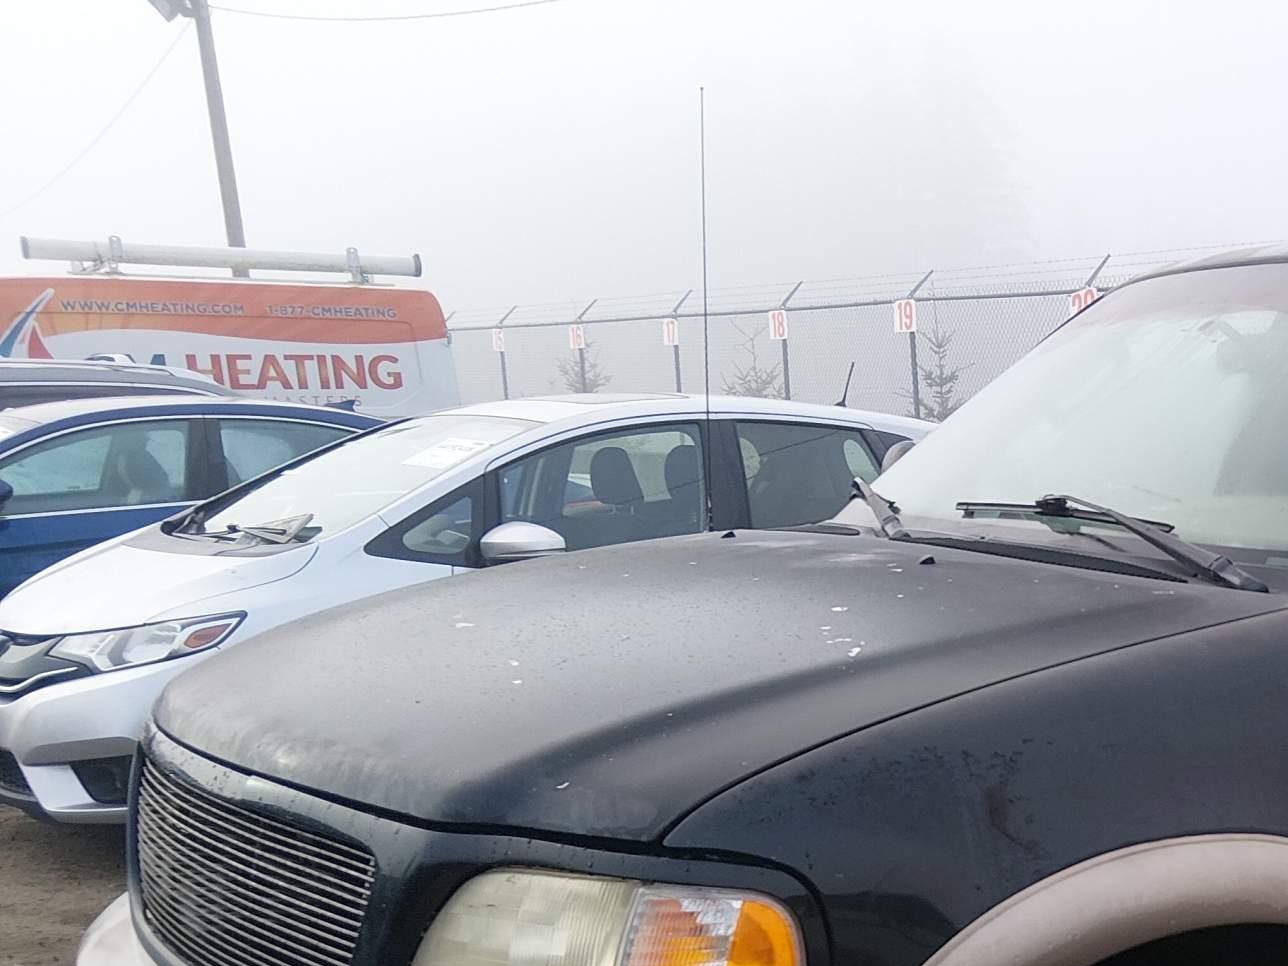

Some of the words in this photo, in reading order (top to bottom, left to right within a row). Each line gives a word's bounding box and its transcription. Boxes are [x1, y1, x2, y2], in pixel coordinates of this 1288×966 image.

[61, 300, 245, 314] WWW.CMHEATING.COM
[268, 305, 397, 318] 1-877-CMHEATING
[897, 301, 914, 331] 19
[771, 311, 785, 338] 18
[185, 353, 403, 390] HEATING
